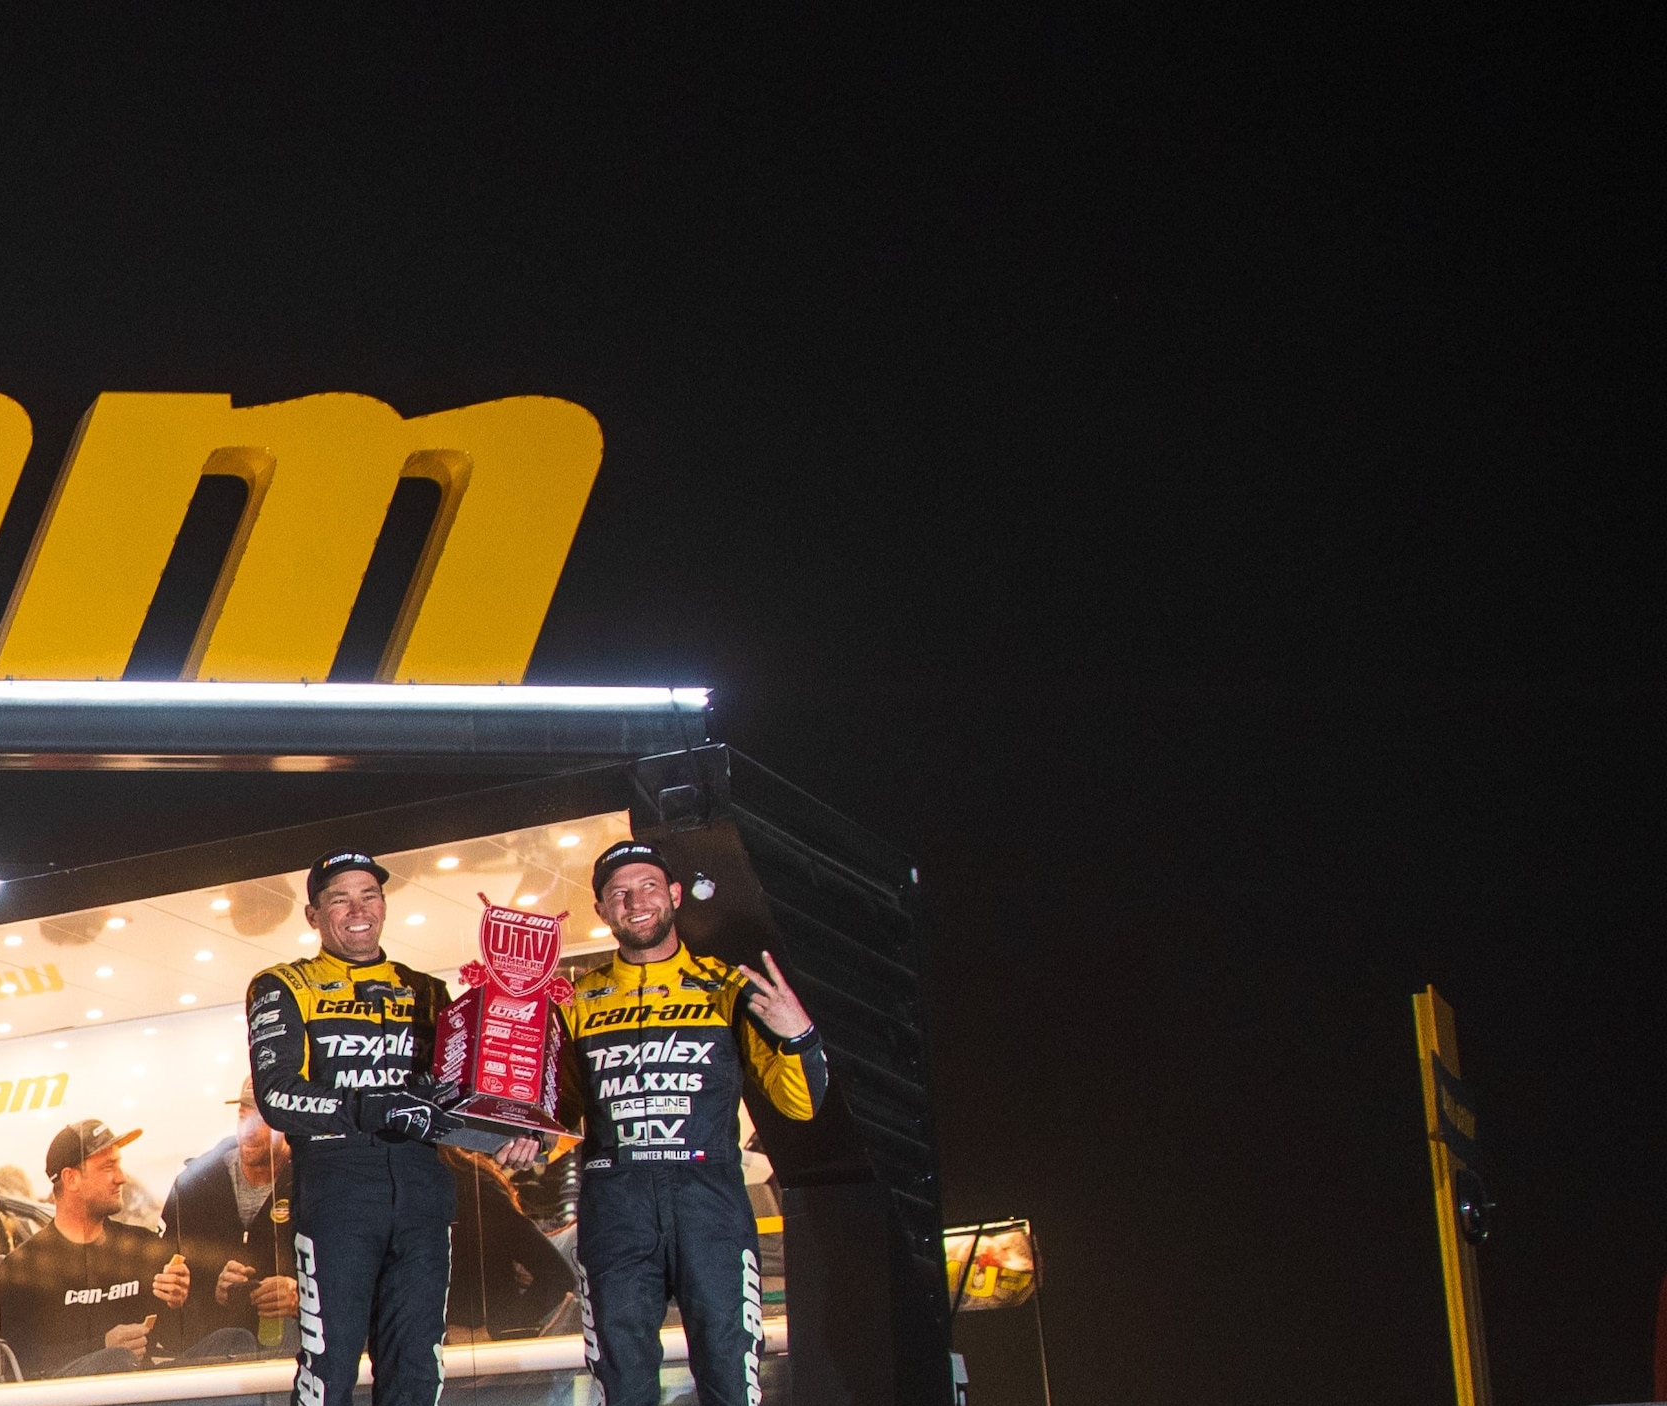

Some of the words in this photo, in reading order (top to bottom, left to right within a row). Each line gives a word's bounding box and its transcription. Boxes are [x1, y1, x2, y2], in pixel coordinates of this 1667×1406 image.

[490, 908, 555, 929] can-am
[488, 921, 553, 963] UTV
[583, 1001, 717, 1031] can-am
[598, 1072, 704, 1100] MAXXIS
[265, 1090, 343, 1115] MAXXIS
[612, 1097, 689, 1119] RACELINE
[631, 1150, 663, 1162] HUNTER
[663, 1150, 691, 1162] MILLER
[64, 1279, 140, 1305] can-am
